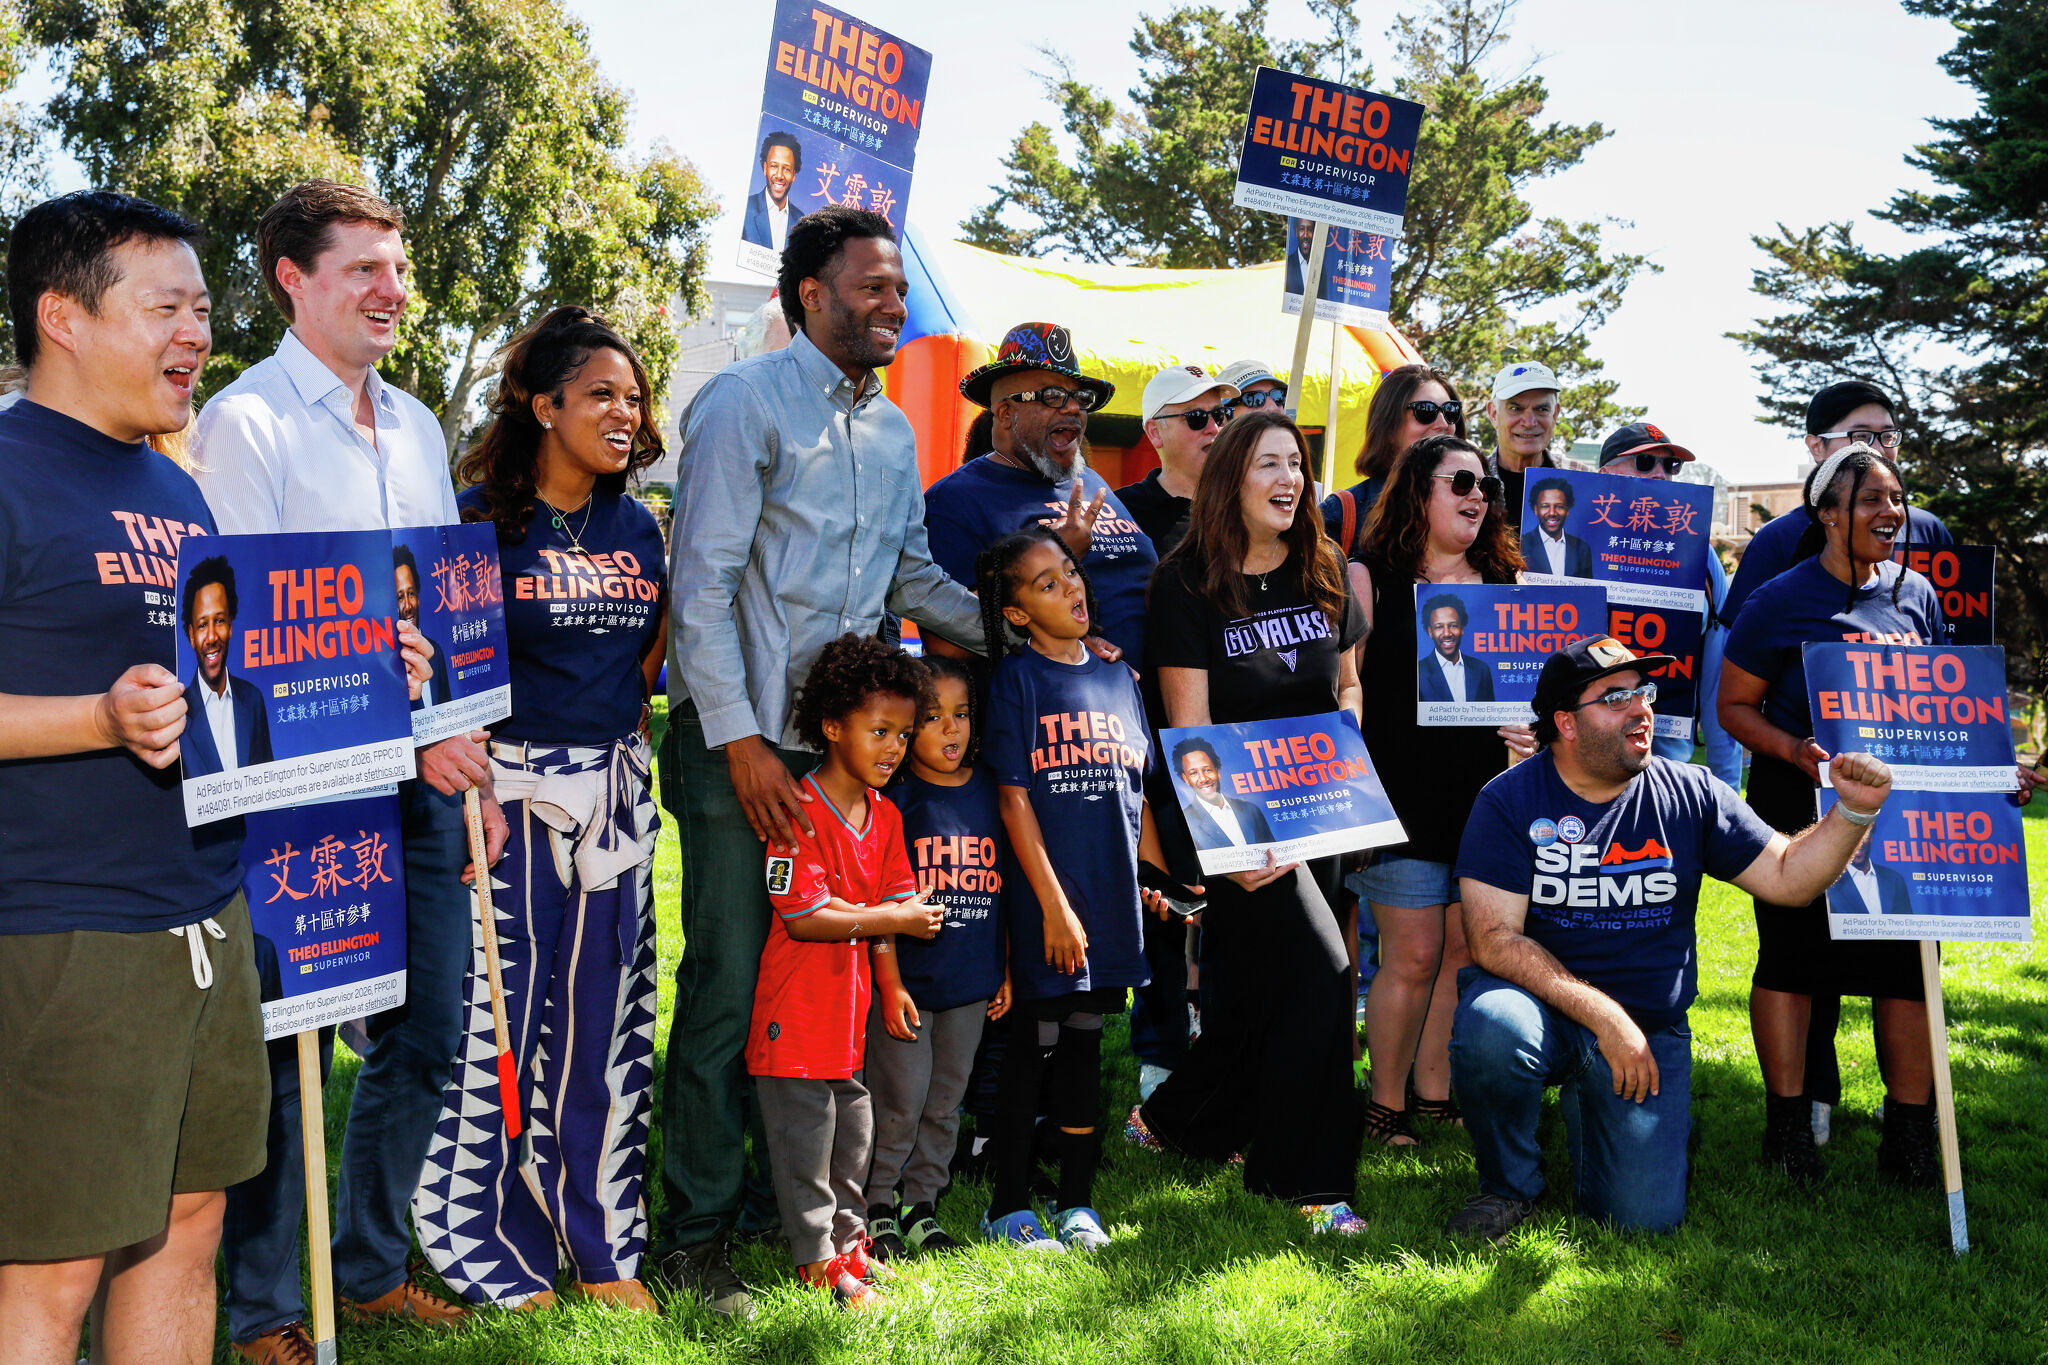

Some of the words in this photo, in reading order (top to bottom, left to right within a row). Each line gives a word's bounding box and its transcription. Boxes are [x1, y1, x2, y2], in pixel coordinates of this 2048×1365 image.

[812, 8, 903, 85] THEO
[775, 40, 921, 129] ELLINGTON
[803, 91, 818, 103] FOR
[819, 97, 888, 136] SUPERVISOR
[1291, 82, 1390, 139] THEO
[1252, 115, 1409, 176] ELLINGTON
[1299, 160, 1376, 186] SUPERVISOR
[1245, 187, 1255, 195] Ad
[1255, 189, 1267, 198] Paid
[1276, 193, 1283, 202] by
[1285, 195, 1299, 205] Theo
[1299, 198, 1323, 210] Ellington
[1330, 205, 1357, 217] Supervisor
[1358, 211, 1372, 221] 2026,
[1373, 214, 1388, 223] FPPC
[1272, 202, 1298, 214] Financial
[1297, 206, 1327, 219] disclosures
[1336, 215, 1357, 227] available
[1588, 493, 1698, 536] 艾霖敦
[1608, 535, 1676, 554] 第十區市參事
[94, 552, 177, 589] ELLIN
[538, 549, 641, 576] THEO
[1600, 553, 1626, 563] THEO
[1627, 555, 1680, 568] ELLINGTON
[1620, 565, 1670, 576] SUPERVISOR
[269, 564, 364, 622] THEO
[431, 551, 498, 613] 艾霖敦
[515, 575, 659, 602] ELLINGTON
[1537, 577, 1550, 585] Paid
[1619, 586, 1651, 597] Supervisor
[1651, 589, 1669, 598] 2026,
[1669, 591, 1687, 599] FPPC
[570, 602, 649, 615] SUPERVISOR
[1494, 603, 1578, 631] THEO
[244, 616, 395, 668] ELLINGTON
[1224, 624, 1258, 657] GO
[1253, 610, 1333, 649] VALKS!
[1473, 632, 1598, 653] ELLINGT
[1609, 610, 1666, 648] EO
[290, 672, 370, 695] SUPERVISOR
[1846, 651, 1966, 693] THEO
[1461, 705, 1469, 714] by
[1486, 706, 1512, 714] Ellington
[1818, 691, 2005, 725] ELLINGTON
[1040, 711, 1126, 744] THEO
[1877, 728, 1969, 742] SUPERVISOR
[1243, 732, 1336, 769] THEO
[196, 784, 207, 799] Ad
[207, 780, 221, 796] Paid
[223, 779, 233, 792] for
[234, 778, 242, 792] by
[244, 774, 263, 788] Theo
[264, 767, 296, 784] Ellington
[297, 764, 308, 777] for
[309, 756, 351, 775] Supervisor
[351, 752, 373, 767] 2026,
[373, 747, 394, 762] FPPC
[395, 746, 403, 759] ID
[1230, 757, 1370, 795] ELLINGTON
[197, 798, 233, 818] #1484091.
[233, 789, 264, 808] Financial
[265, 783, 307, 802] disclosures
[308, 783, 321, 793] are
[322, 773, 355, 790] available
[355, 773, 363, 783] at
[364, 764, 406, 783] sfethics.org
[1281, 789, 1351, 807] SUPERVISOR
[1902, 810, 1993, 841] THEO
[264, 830, 393, 904] 艾霖敦
[914, 835, 996, 868] THEO
[1535, 842, 1600, 874] SF
[1884, 841, 2019, 865] ELLINGTON
[912, 867, 1002, 893] LINGTO
[1532, 872, 1678, 907] DEMS
[1927, 872, 1994, 883] SUPERVISOR
[930, 894, 992, 906] SUPERVISOR
[1572, 906, 1673, 922] FRANCISCO
[295, 902, 371, 936] 第十區市參事
[1540, 914, 1622, 930] MOCATIC
[1626, 917, 1671, 929] PARTY
[1877, 928, 1905, 936] Financial
[1878, 919, 1886, 927] by
[1904, 919, 1932, 928] Ellington
[288, 943, 320, 963] THEO
[321, 931, 380, 956] ELLINGTON
[314, 951, 371, 972] SUPERVISOR
[272, 1003, 304, 1018] Ellington
[305, 1001, 316, 1010] for
[317, 992, 354, 1008] Supervisor
[354, 986, 373, 999] 2026,
[374, 981, 390, 993] FPPC
[390, 979, 397, 989] ID
[272, 1016, 313, 1032] disclosures
[326, 1006, 357, 1020] available
